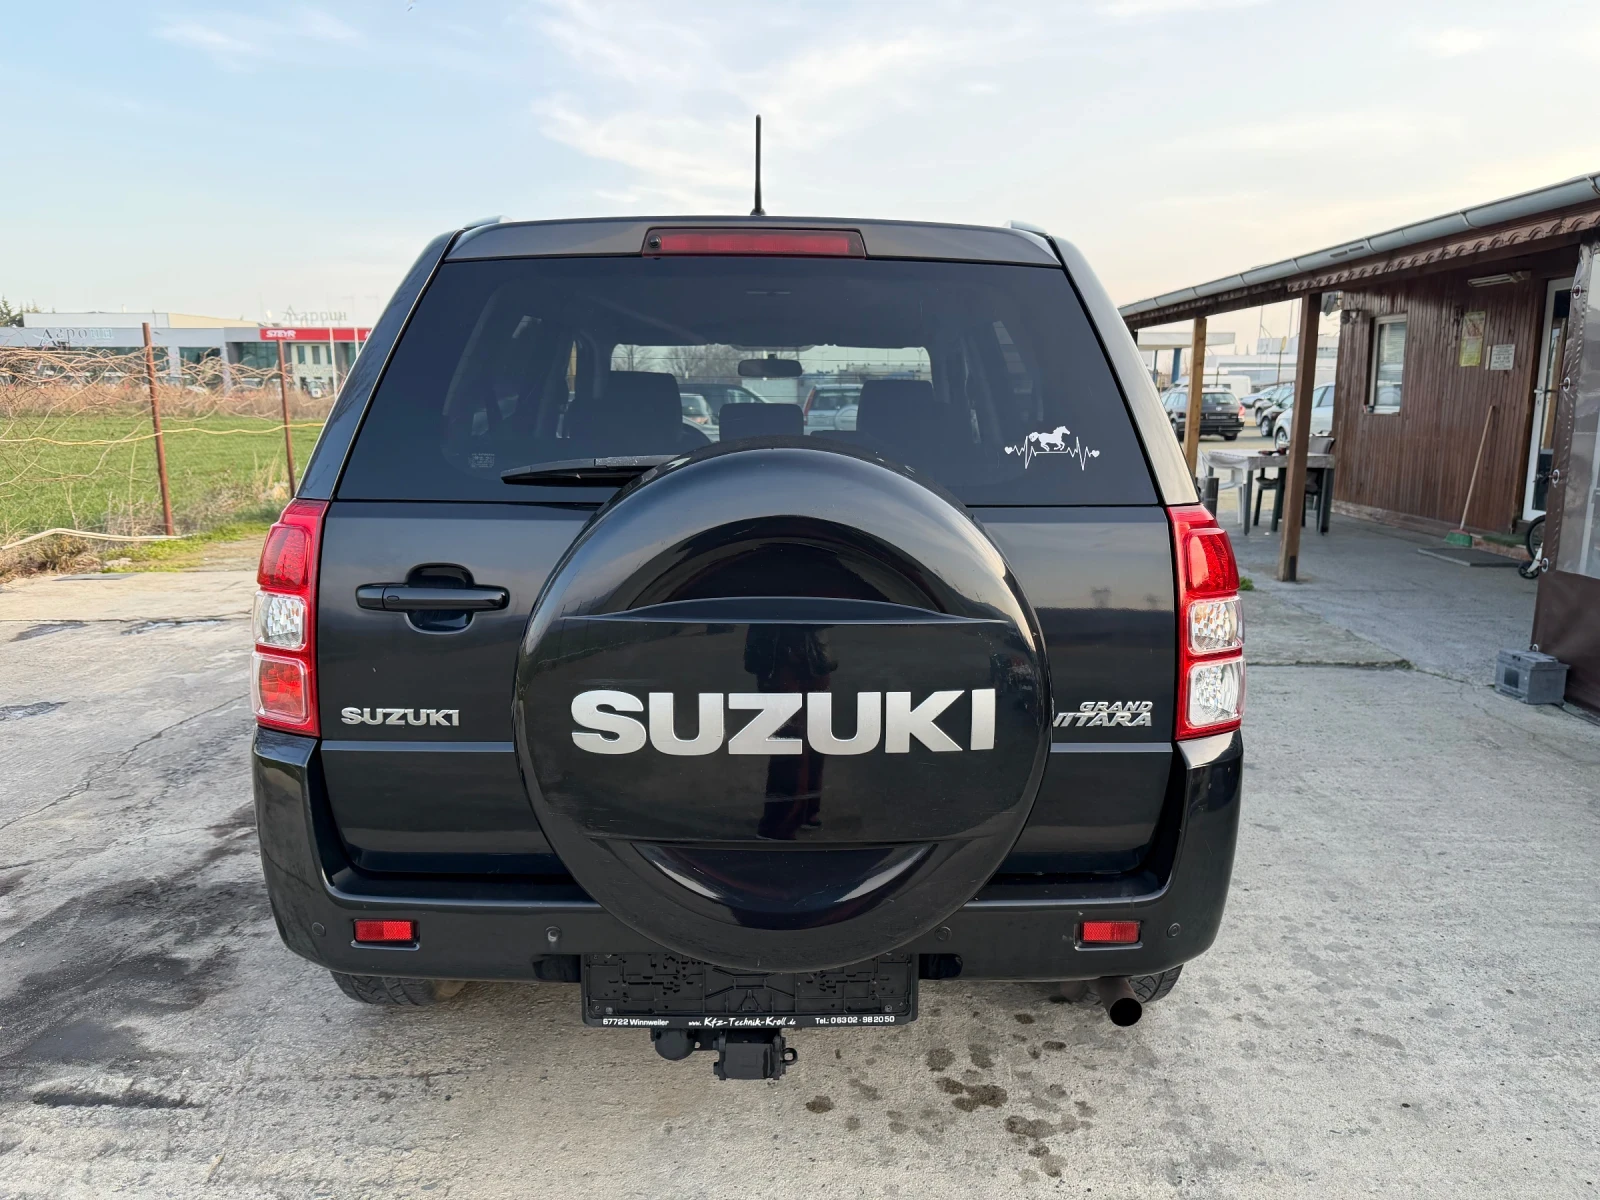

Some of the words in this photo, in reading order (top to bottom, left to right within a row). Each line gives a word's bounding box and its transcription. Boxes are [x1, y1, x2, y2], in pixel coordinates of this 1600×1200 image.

[266, 329, 297, 339] STEYR
[1079, 701, 1153, 713] GRAND
[340, 706, 460, 726] SUZUKI
[571, 689, 996, 756] SUZUKI
[602, 1018, 629, 1026] 67722
[629, 1018, 670, 1026] Winnweiler
